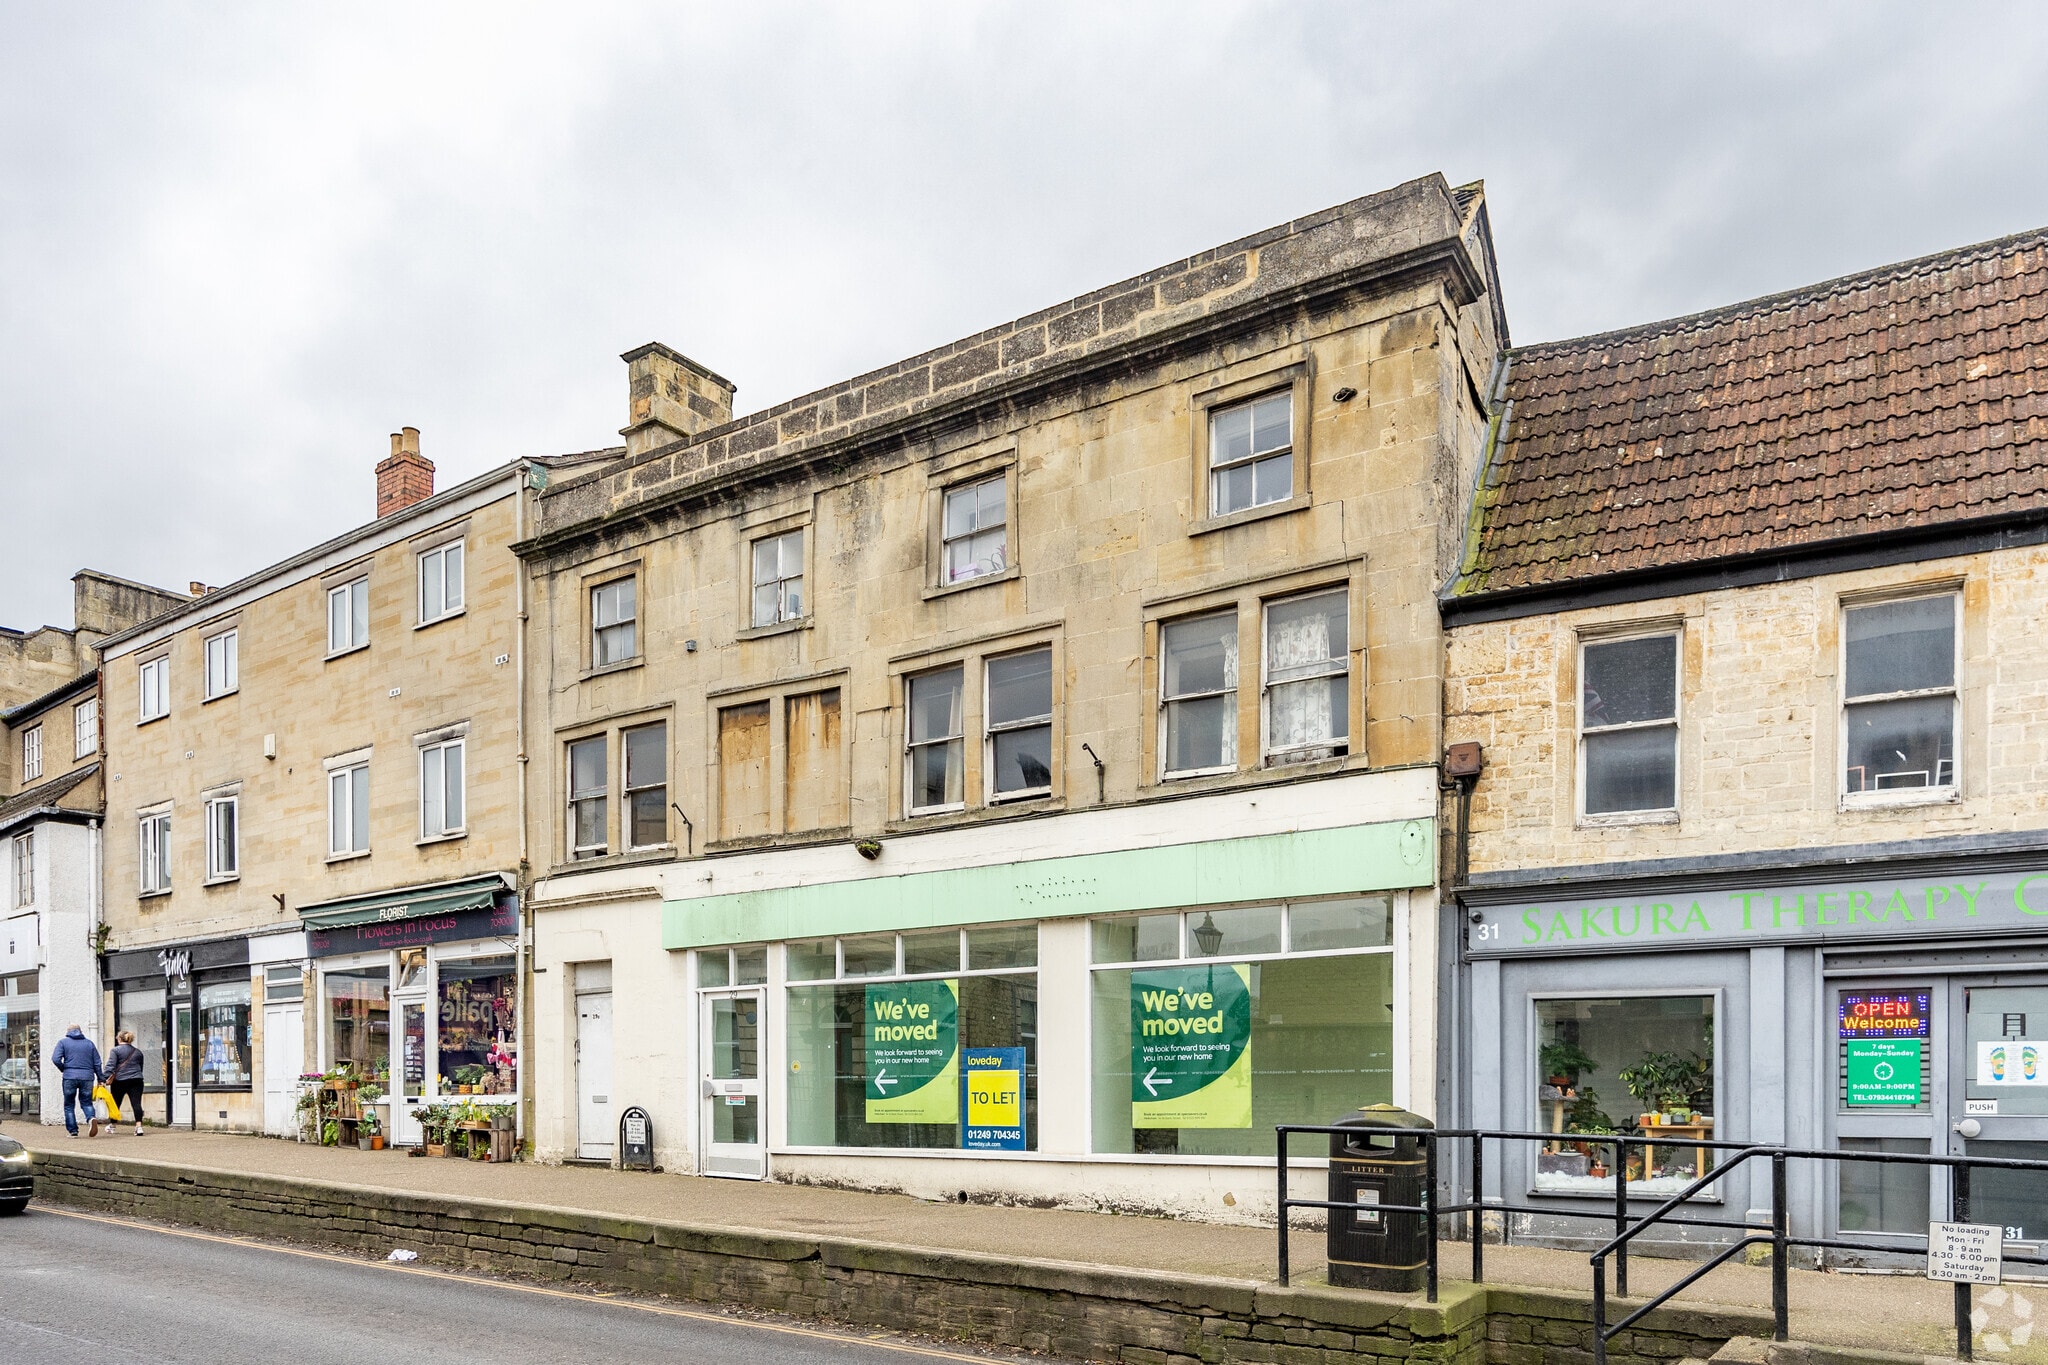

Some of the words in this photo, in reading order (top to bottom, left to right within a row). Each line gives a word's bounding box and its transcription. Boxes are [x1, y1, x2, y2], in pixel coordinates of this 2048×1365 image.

[380, 906, 408, 919] FLORIST
[1521, 900, 1714, 944] SAKURA
[1729, 881, 1990, 930] THERAPY
[357, 923, 402, 939] Flowers
[404, 921, 416, 933] in
[418, 916, 457, 932] Focus
[1478, 923, 1500, 940] 31
[1142, 986, 1214, 1012] We've
[874, 998, 930, 1020] We've
[1854, 1002, 1910, 1016] OPEN
[1142, 1010, 1224, 1036] moved
[1844, 1017, 1920, 1030] Welcome
[874, 1020, 938, 1042] moved
[925, 1048, 942, 1056] seeing
[1170, 1044, 1198, 1052] forward
[1208, 1042, 1230, 1052] seeing
[967, 1056, 1002, 1067] loveday
[972, 1092, 988, 1104] TO
[993, 1092, 1016, 1104] LET
[968, 1130, 991, 1139] 01249
[993, 1130, 1020, 1140] 704345
[1958, 1226, 1990, 1236] loading
[2005, 1226, 2022, 1239] 31
[1960, 1253, 1982, 1261] 6.00
[1944, 1262, 1984, 1272] Saturday
